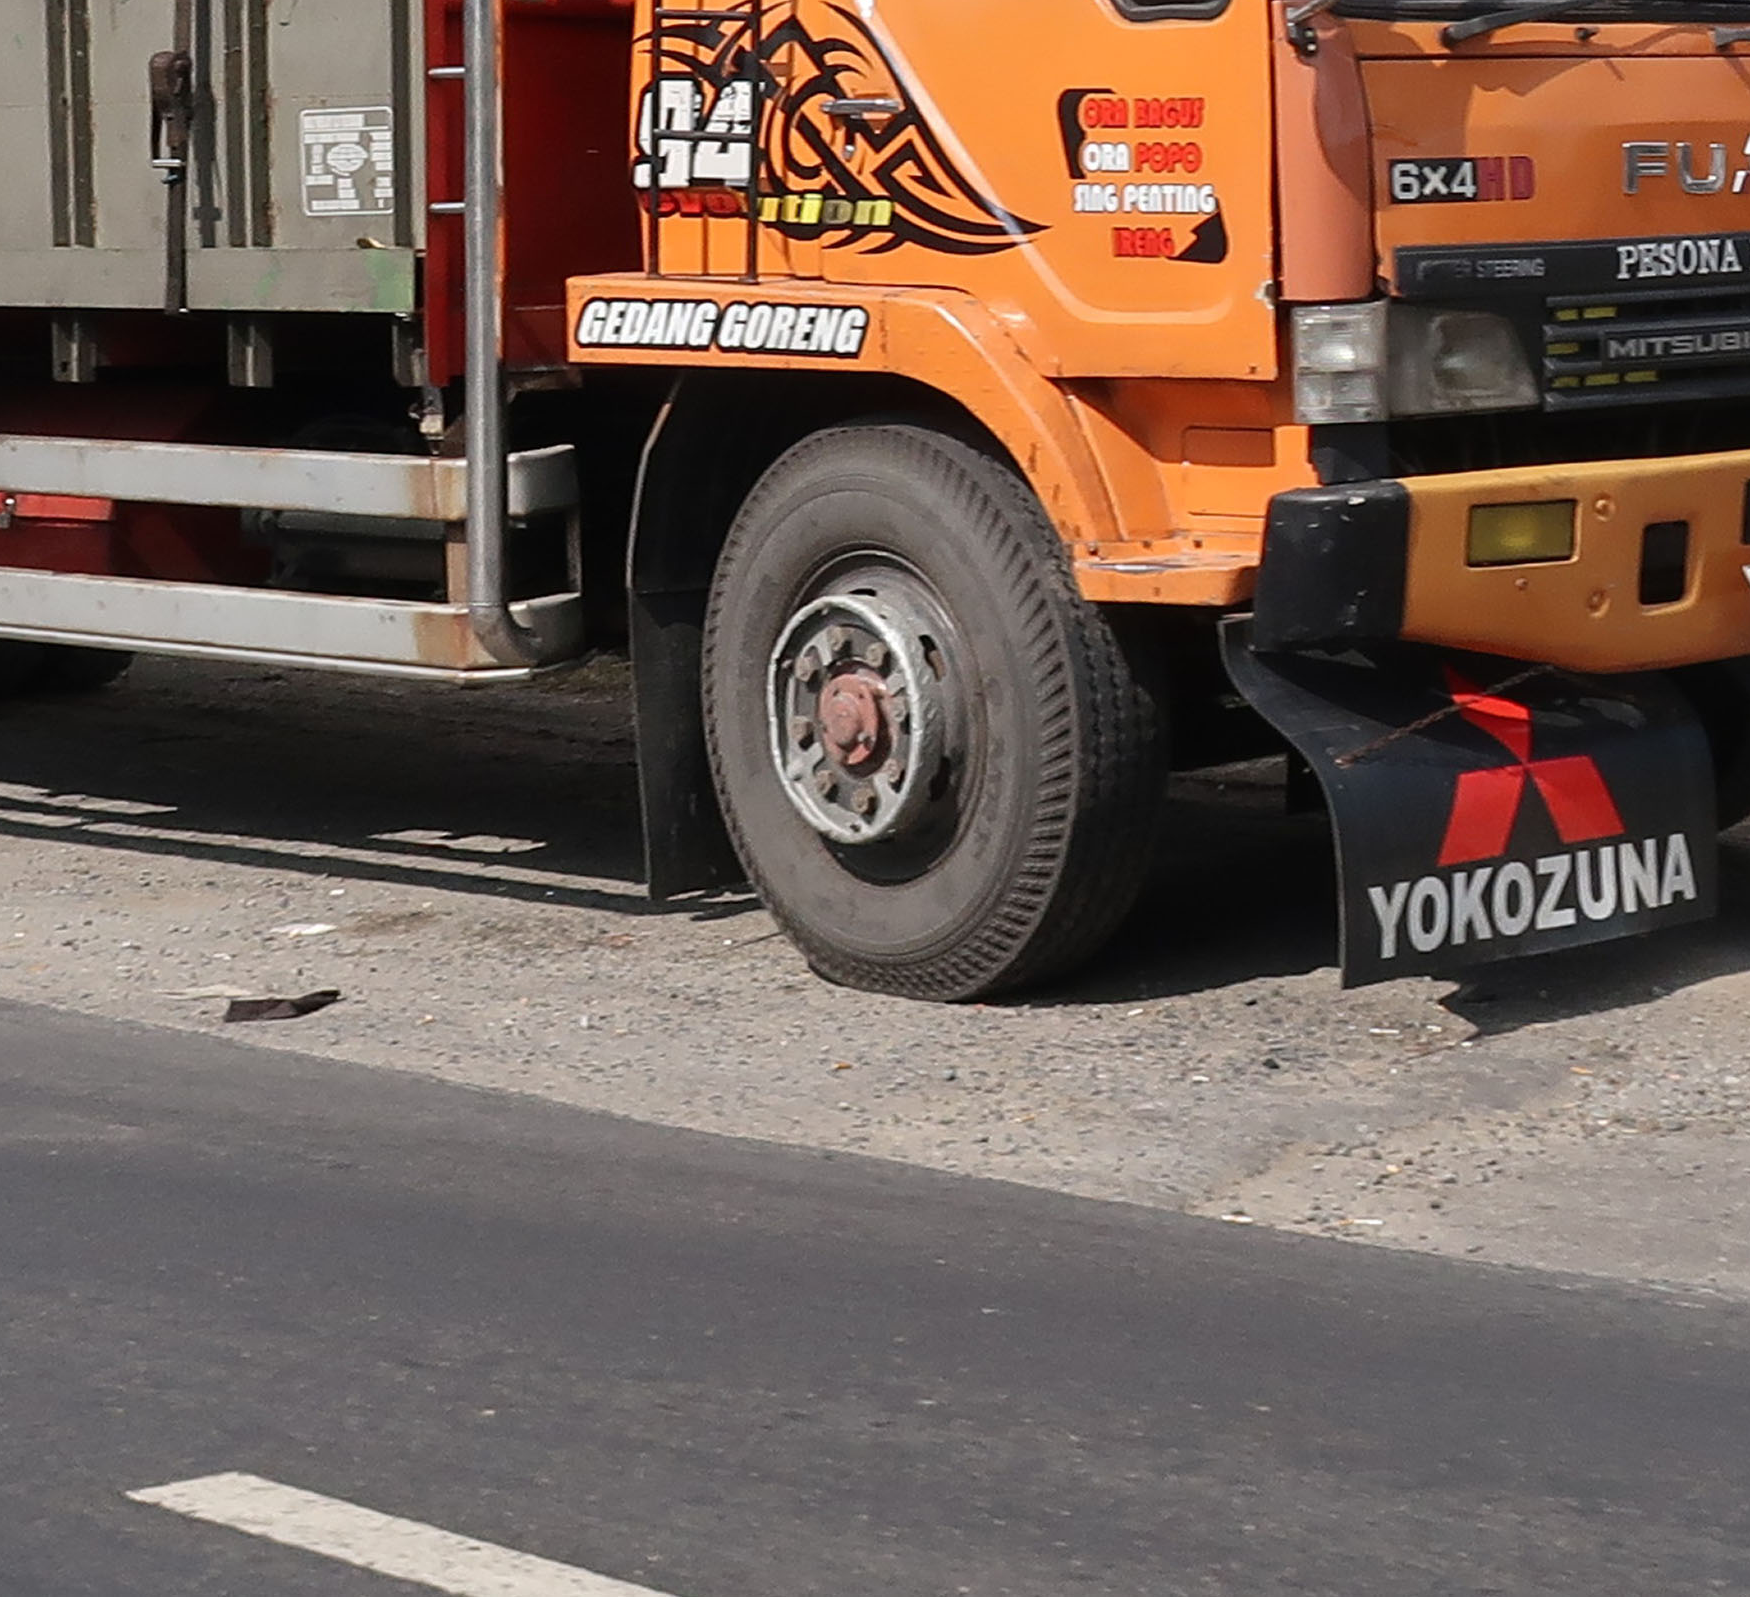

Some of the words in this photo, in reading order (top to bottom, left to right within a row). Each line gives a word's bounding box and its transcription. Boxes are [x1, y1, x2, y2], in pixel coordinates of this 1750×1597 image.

[1084, 98, 1128, 128] ORA
[1134, 97, 1205, 128] BAGUS
[1082, 142, 1130, 172] ORA
[1134, 142, 1202, 173] POPO
[1073, 183, 1119, 213] SING
[1122, 183, 1217, 215] PENTING
[1617, 237, 1742, 280] PESONA
[576, 298, 720, 348] GEDANG
[716, 300, 868, 354] GORENG
[1367, 833, 1696, 960] YOKOZUNA
